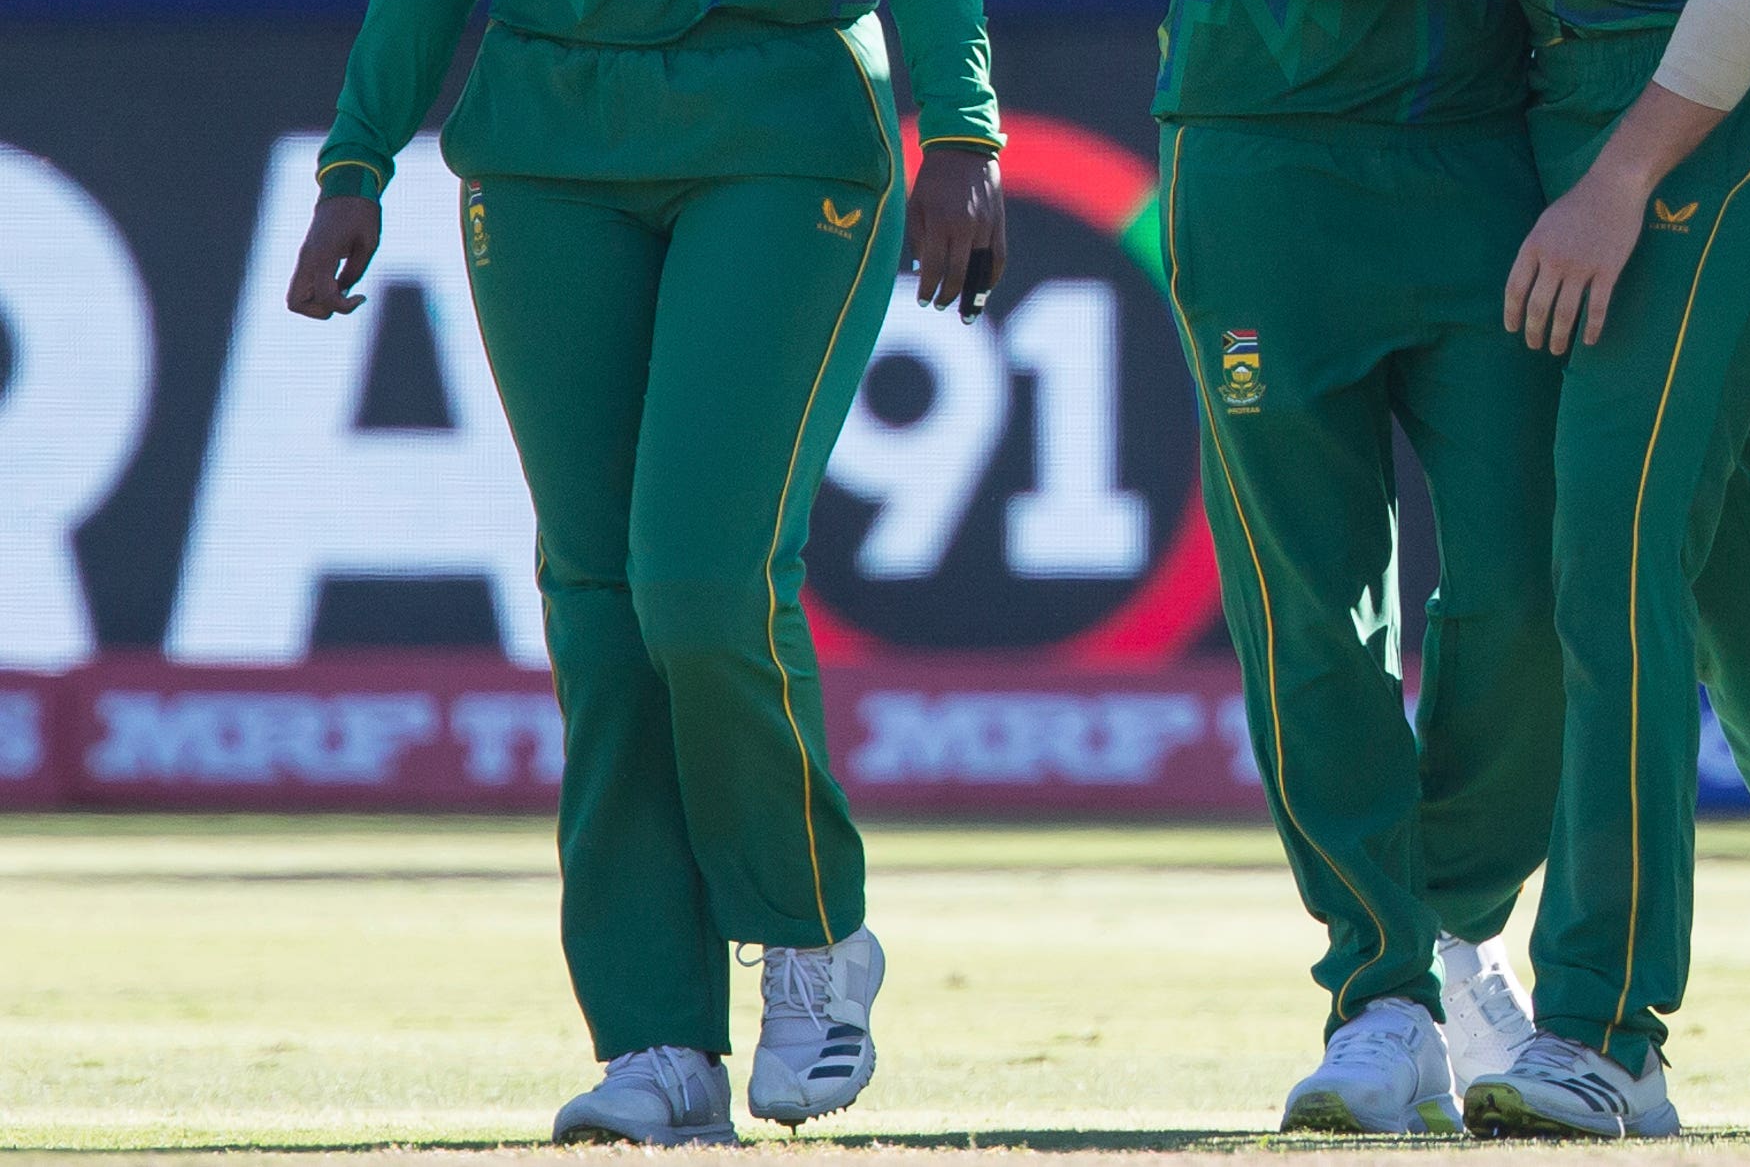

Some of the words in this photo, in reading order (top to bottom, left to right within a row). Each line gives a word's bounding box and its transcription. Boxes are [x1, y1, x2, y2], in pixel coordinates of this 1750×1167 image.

[826, 274, 1151, 580] 91
[88, 689, 434, 785] MRF
[850, 690, 1202, 785] MRF
